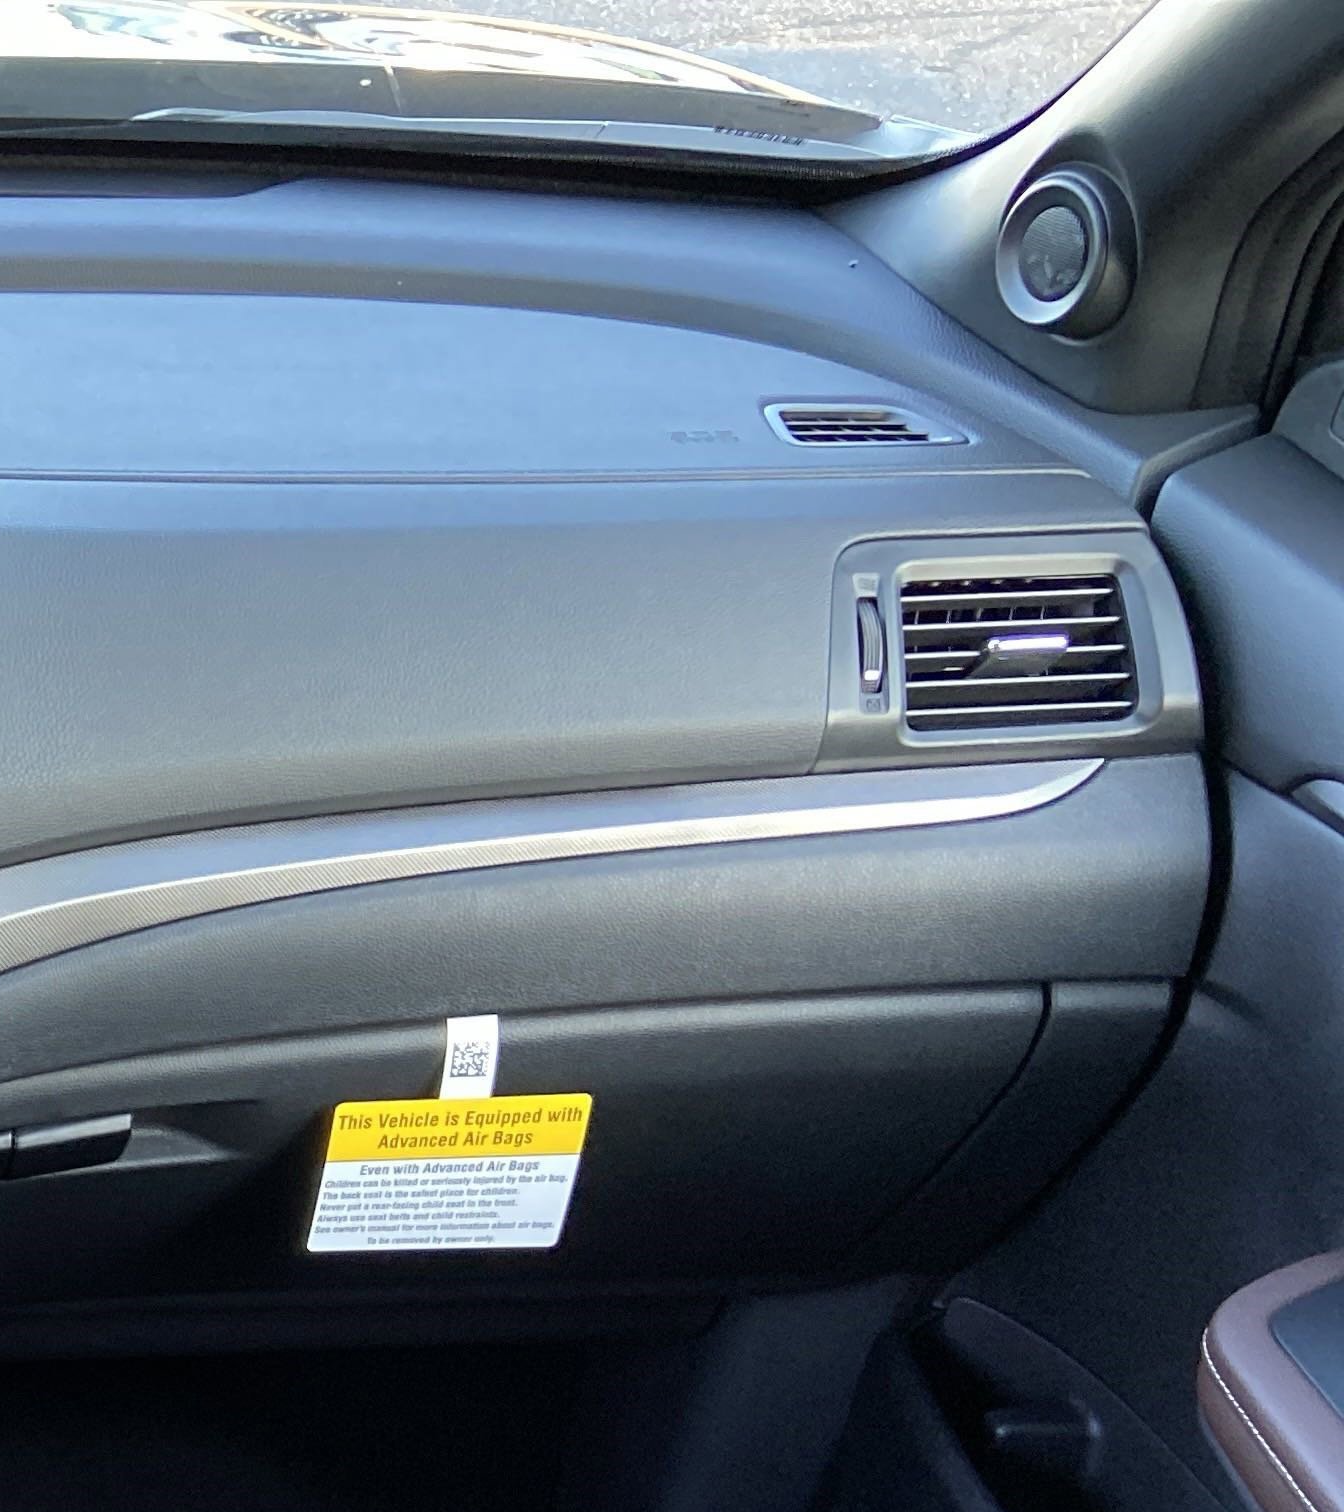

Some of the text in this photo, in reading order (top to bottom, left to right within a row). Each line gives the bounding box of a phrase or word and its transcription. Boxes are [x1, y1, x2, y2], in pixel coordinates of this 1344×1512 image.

[338, 1107, 583, 1130] This Vehicle is Equipped with
[378, 1130, 533, 1149] Advanced Air Bags
[360, 1160, 540, 1176] Even with Advanced Air Bags
[431, 1177, 471, 1185] seriously
[473, 1176, 504, 1184] injured
[506, 1176, 517, 1184] by
[549, 1174, 568, 1183] bag.
[323, 1192, 338, 1200] The
[440, 1189, 464, 1197] place
[347, 1203, 362, 1211] put
[372, 1202, 420, 1210] rear-facing
[446, 1200, 465, 1208] seat
[317, 1215, 348, 1223] Always
[433, 1236, 442, 1244] by
